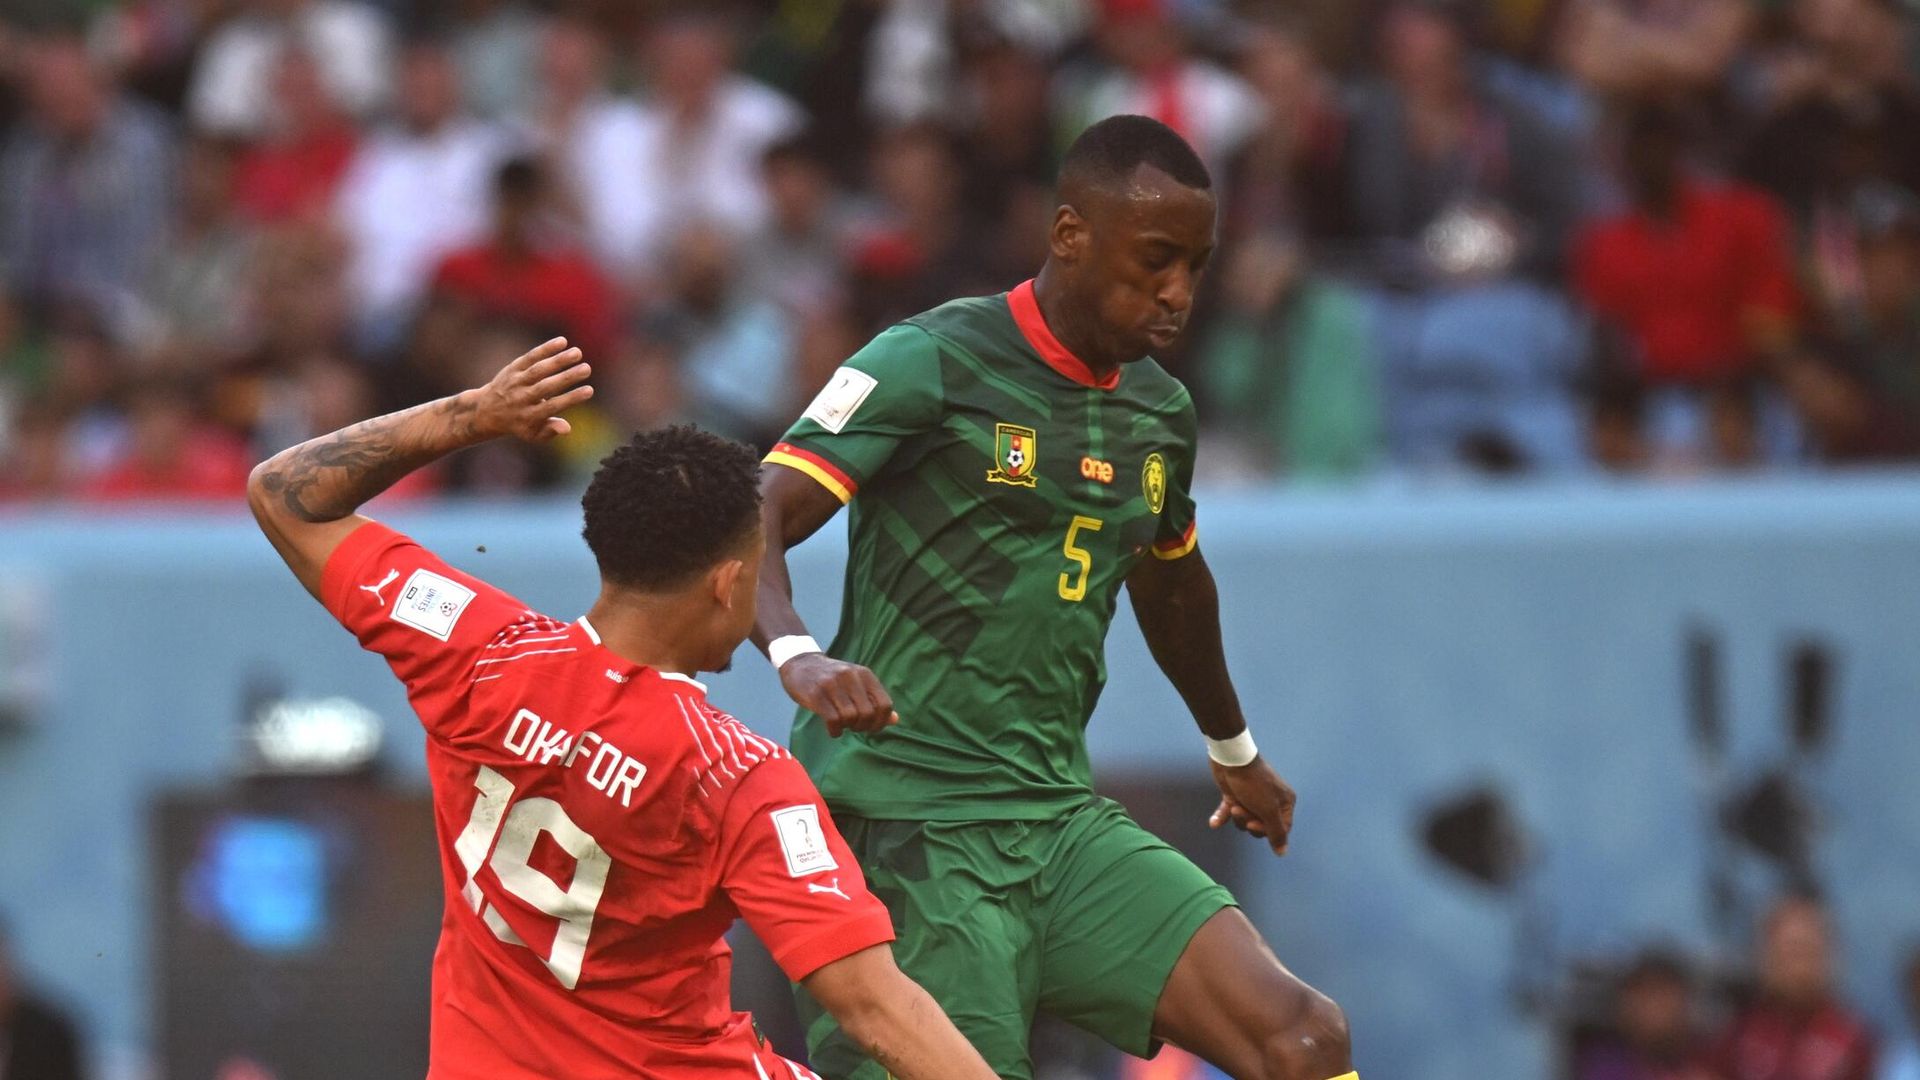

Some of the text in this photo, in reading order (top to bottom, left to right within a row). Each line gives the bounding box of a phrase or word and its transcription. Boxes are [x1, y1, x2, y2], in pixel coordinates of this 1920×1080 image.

[1081, 457, 1114, 483] one
[417, 588, 437, 612] UNITES
[1058, 515, 1103, 601] 5
[503, 708, 647, 807] OKAFOR
[454, 765, 612, 990] 19
